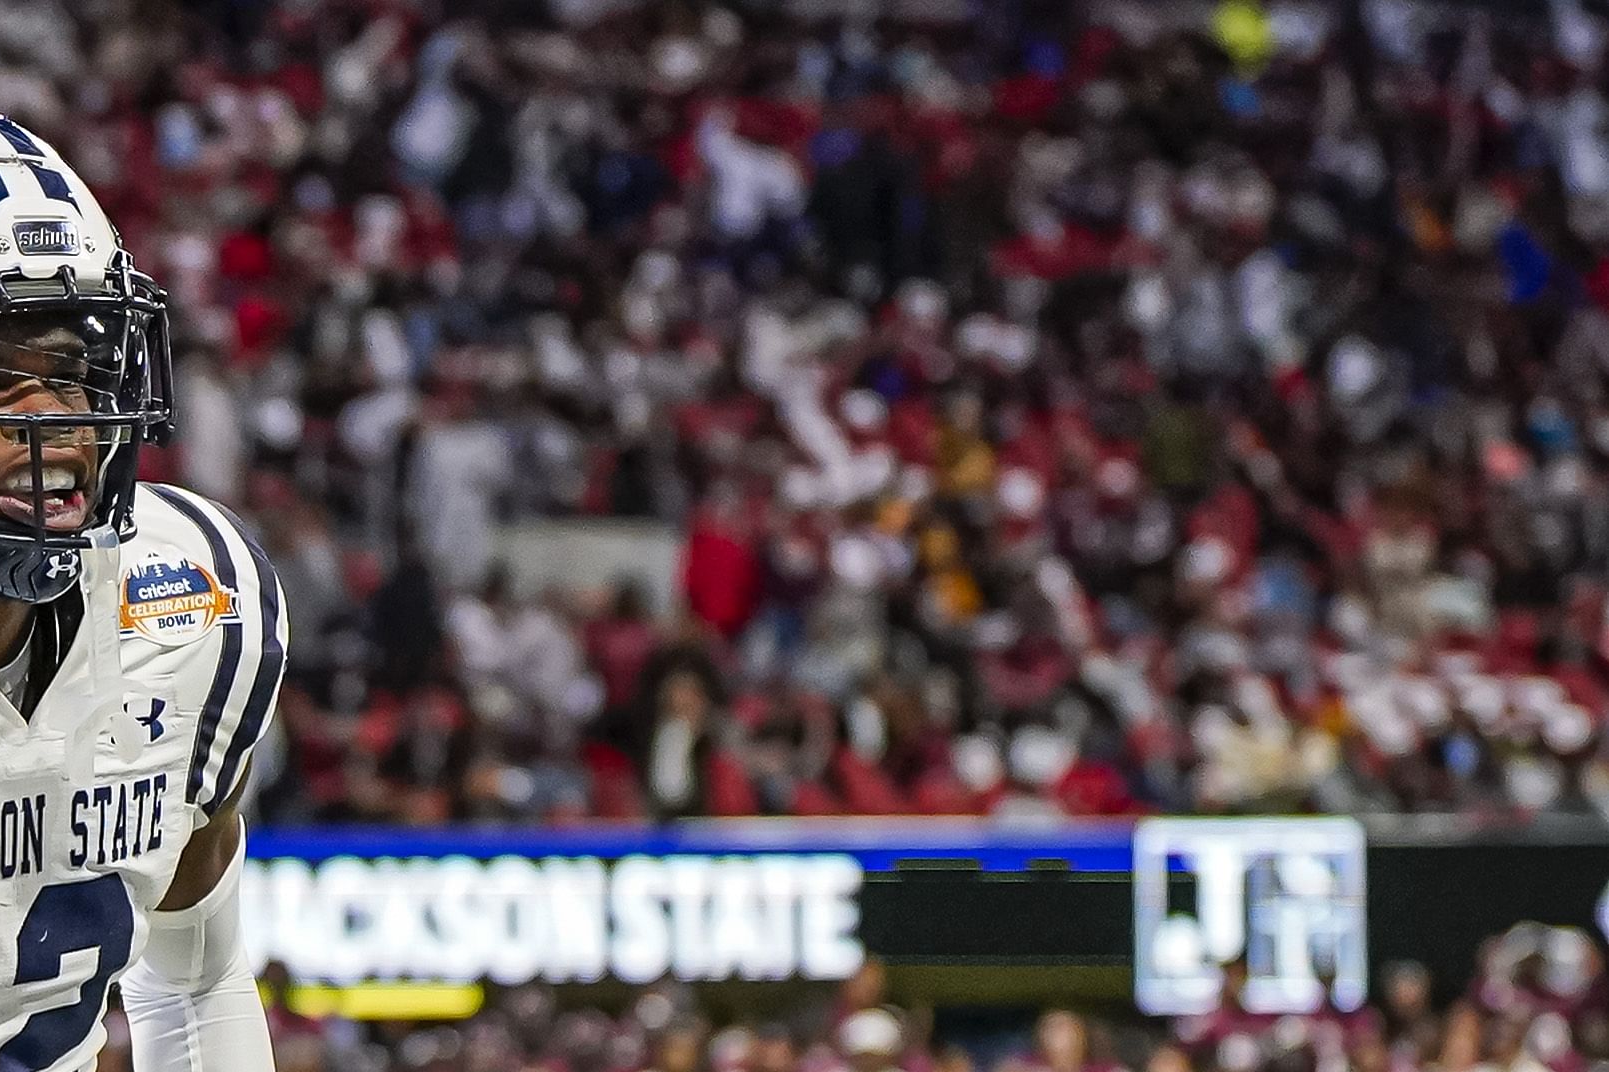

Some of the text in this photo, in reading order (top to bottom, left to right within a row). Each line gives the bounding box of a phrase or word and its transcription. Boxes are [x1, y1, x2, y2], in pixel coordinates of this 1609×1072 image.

[138, 577, 193, 600] cricket
[128, 593, 217, 618] CELEBRATION
[157, 613, 196, 630] BOWL
[70, 772, 168, 868] STATE
[606, 853, 865, 985] STATE
